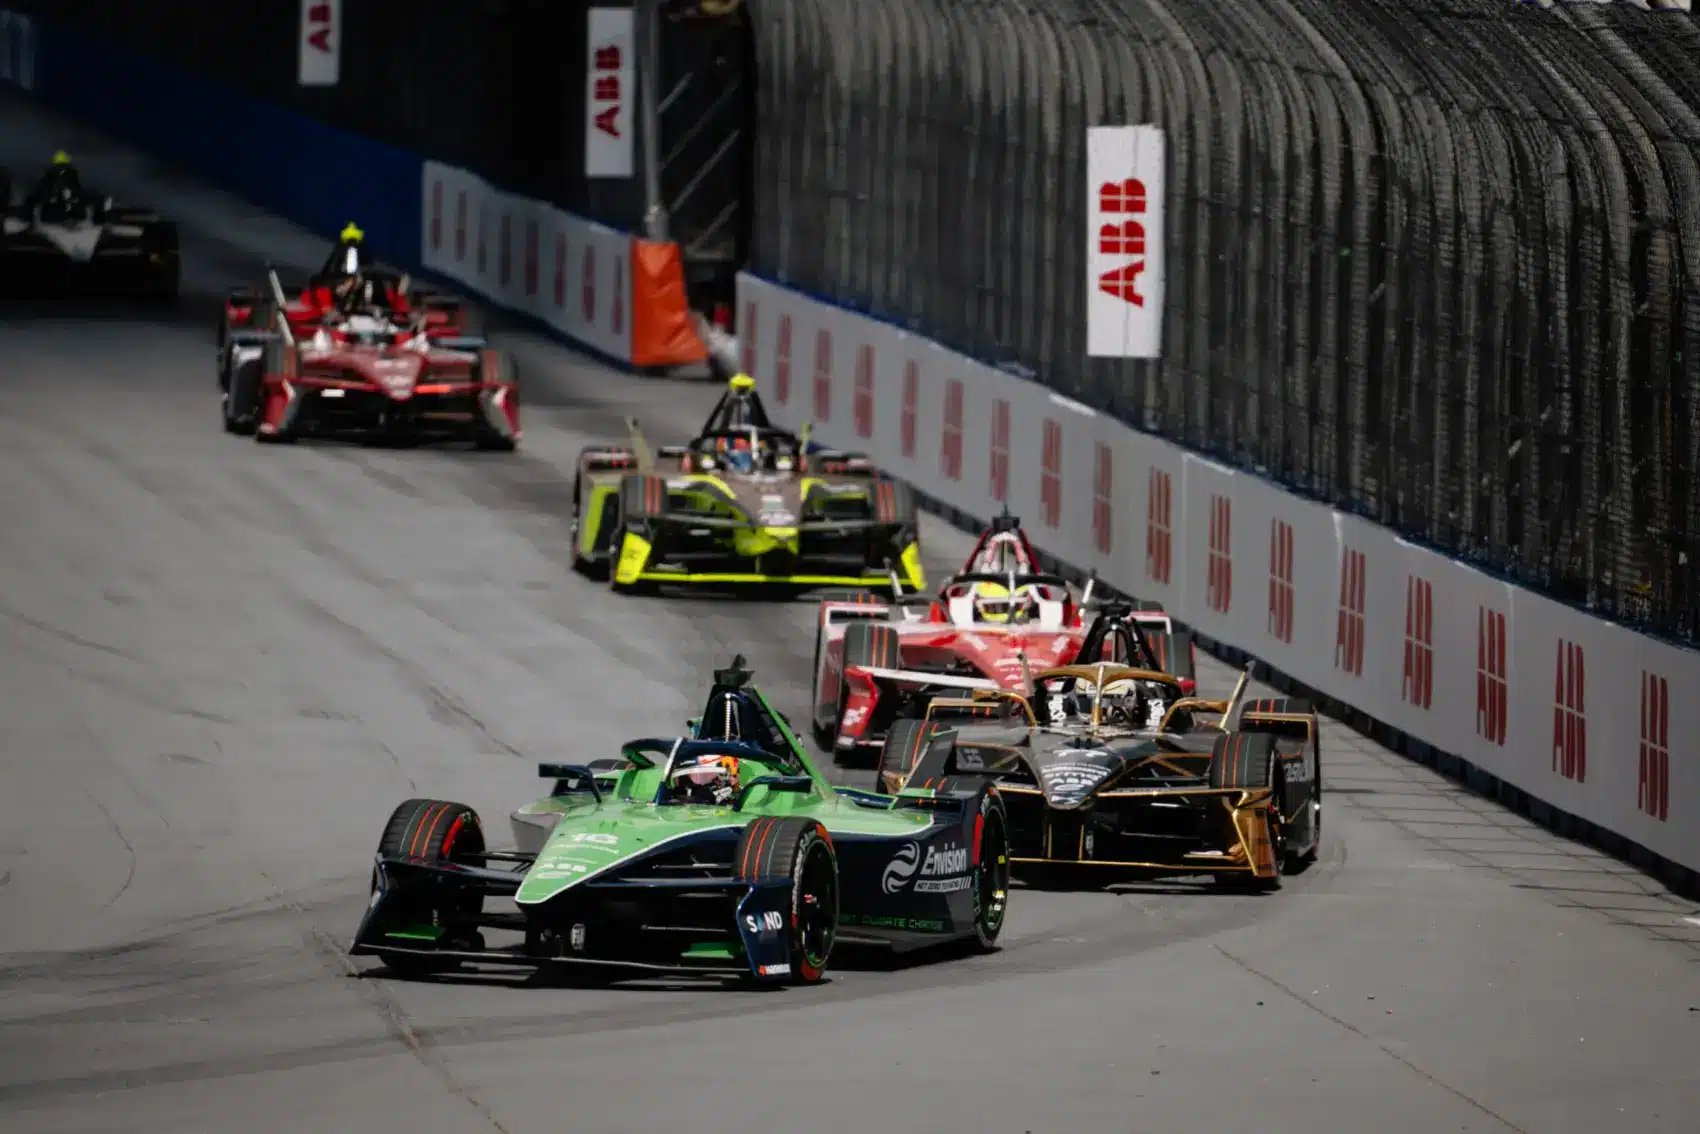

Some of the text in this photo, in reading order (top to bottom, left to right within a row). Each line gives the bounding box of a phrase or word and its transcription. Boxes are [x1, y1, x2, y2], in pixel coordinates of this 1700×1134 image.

[594, 45, 622, 138] ABB
[1098, 178, 1147, 308] ABB
[920, 842, 967, 875] Envision
